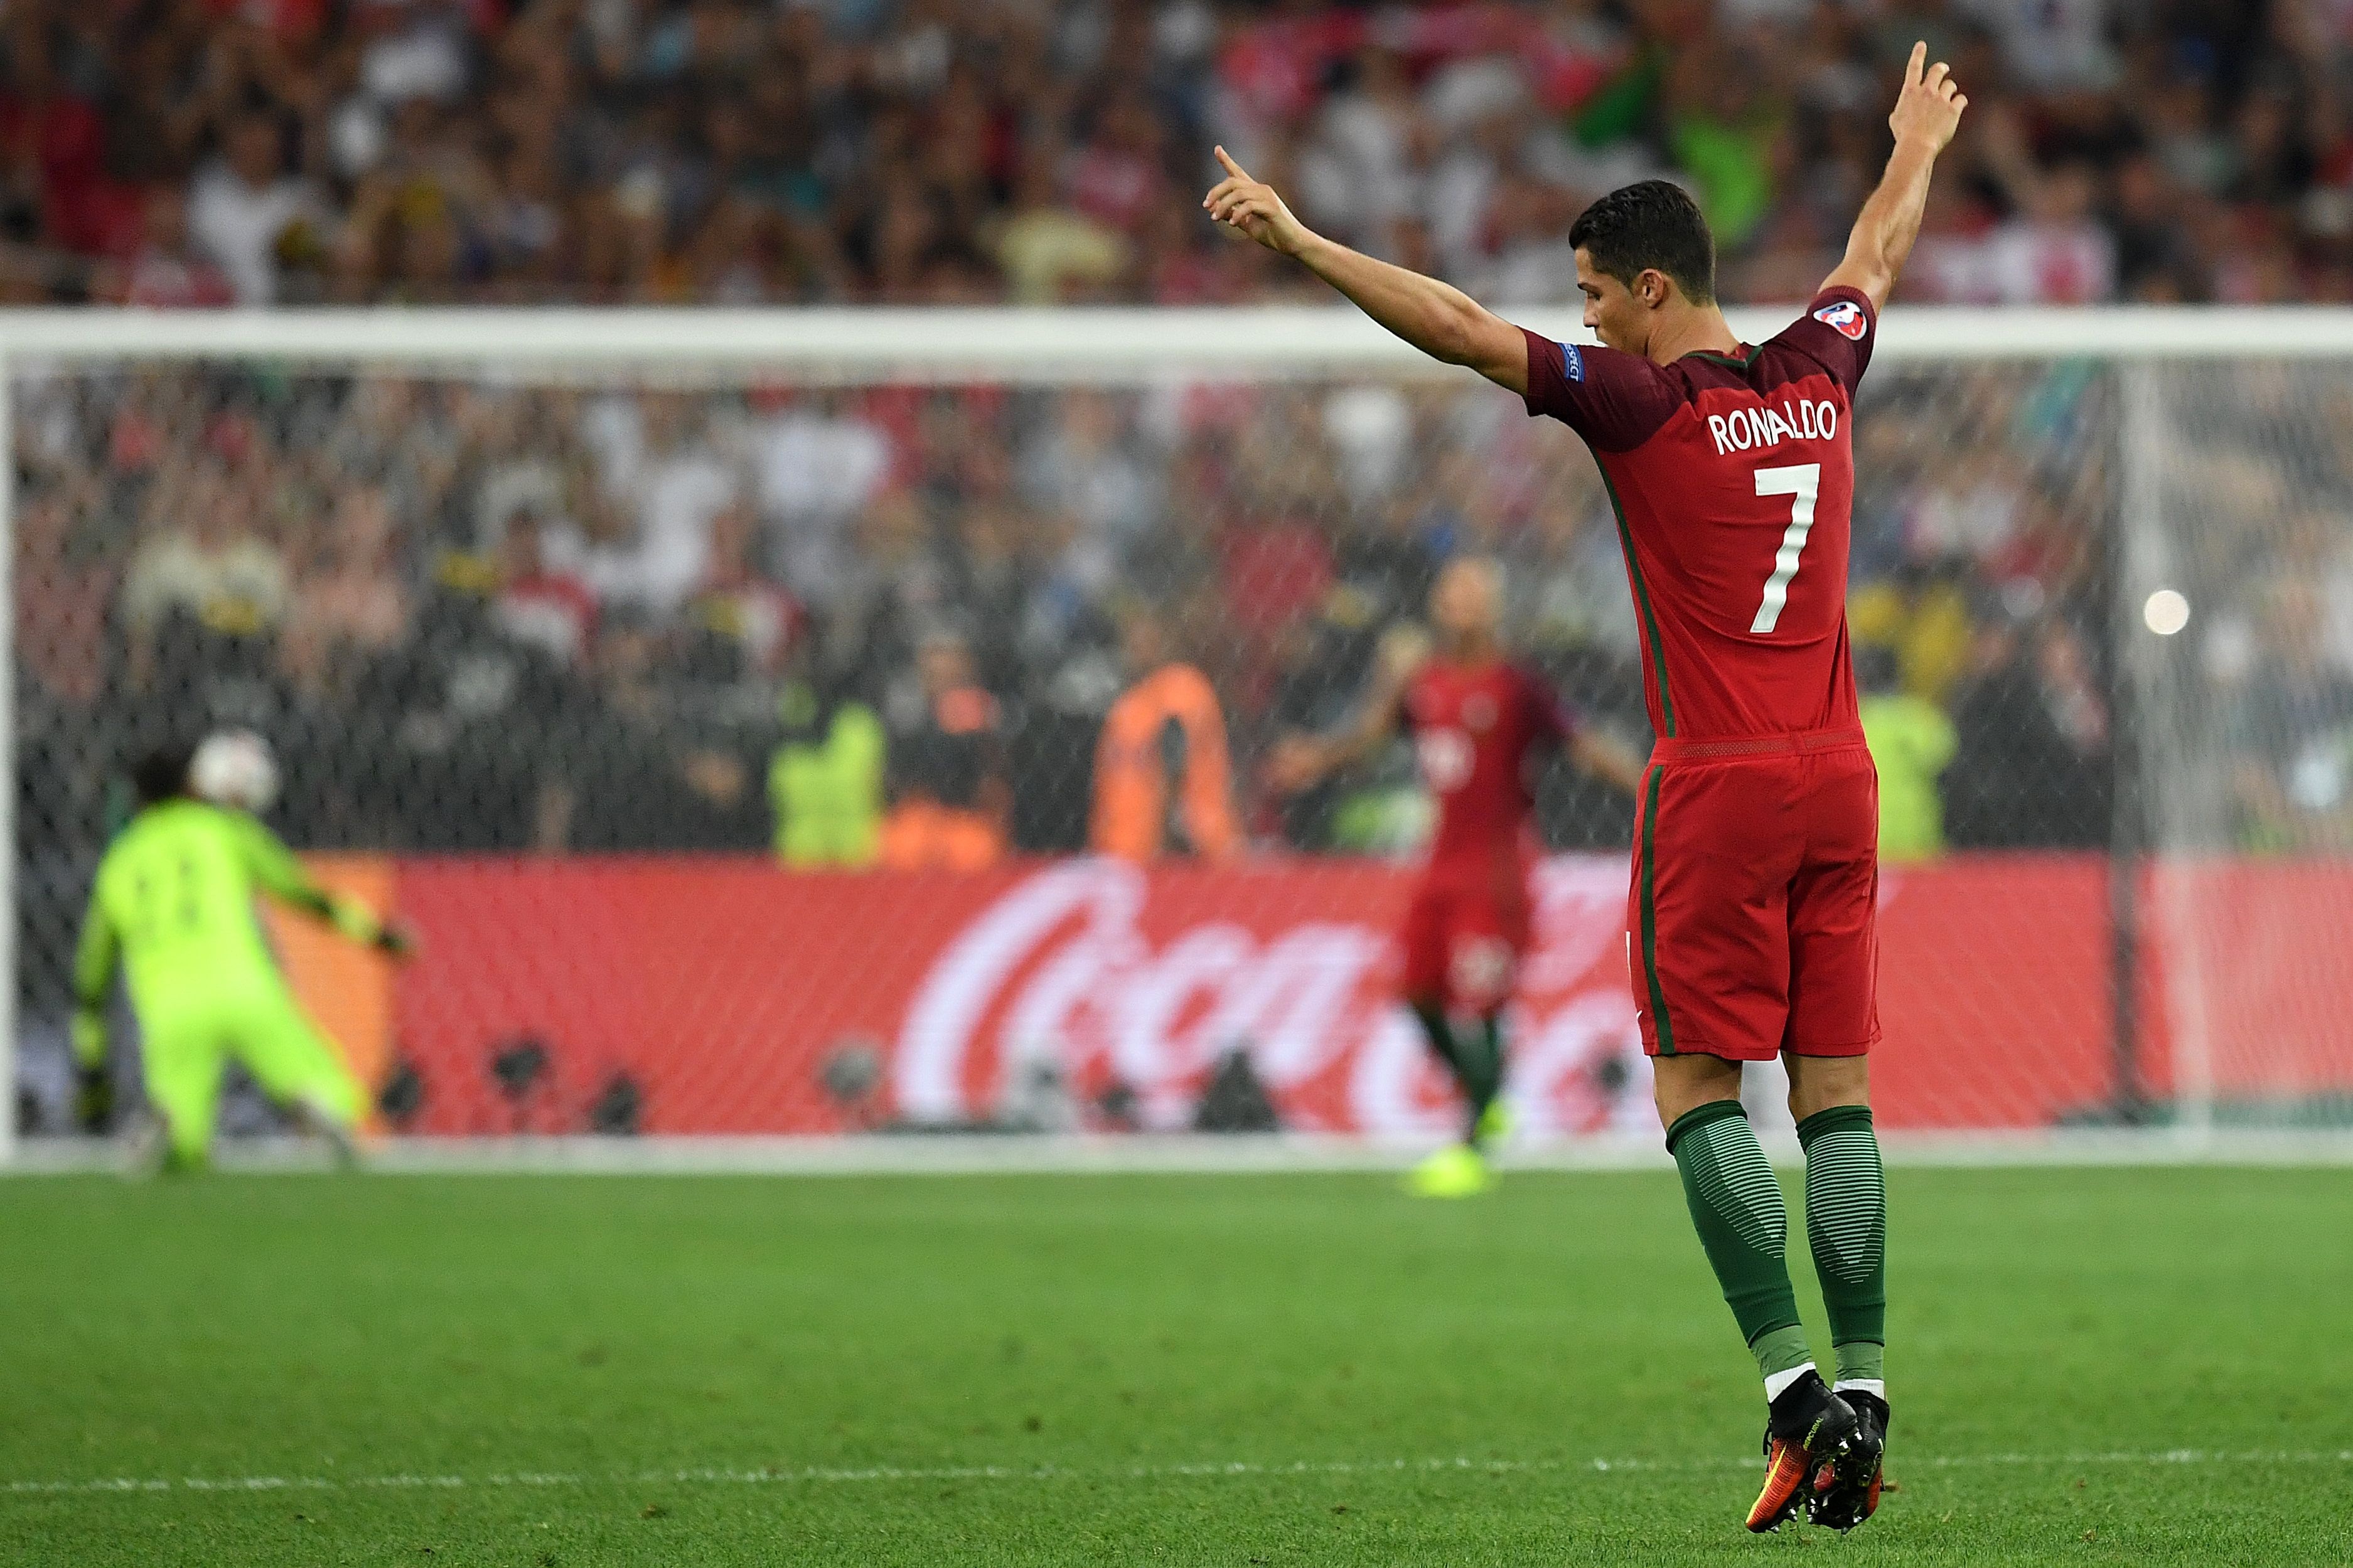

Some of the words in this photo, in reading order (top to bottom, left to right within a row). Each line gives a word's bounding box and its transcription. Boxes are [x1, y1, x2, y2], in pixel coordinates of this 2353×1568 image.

[1563, 344, 1579, 382] ESPECT
[1708, 399, 1836, 456] RONALDO
[1750, 463, 1821, 633] 7
[1803, 1417, 1824, 1451] MERCURIAL
